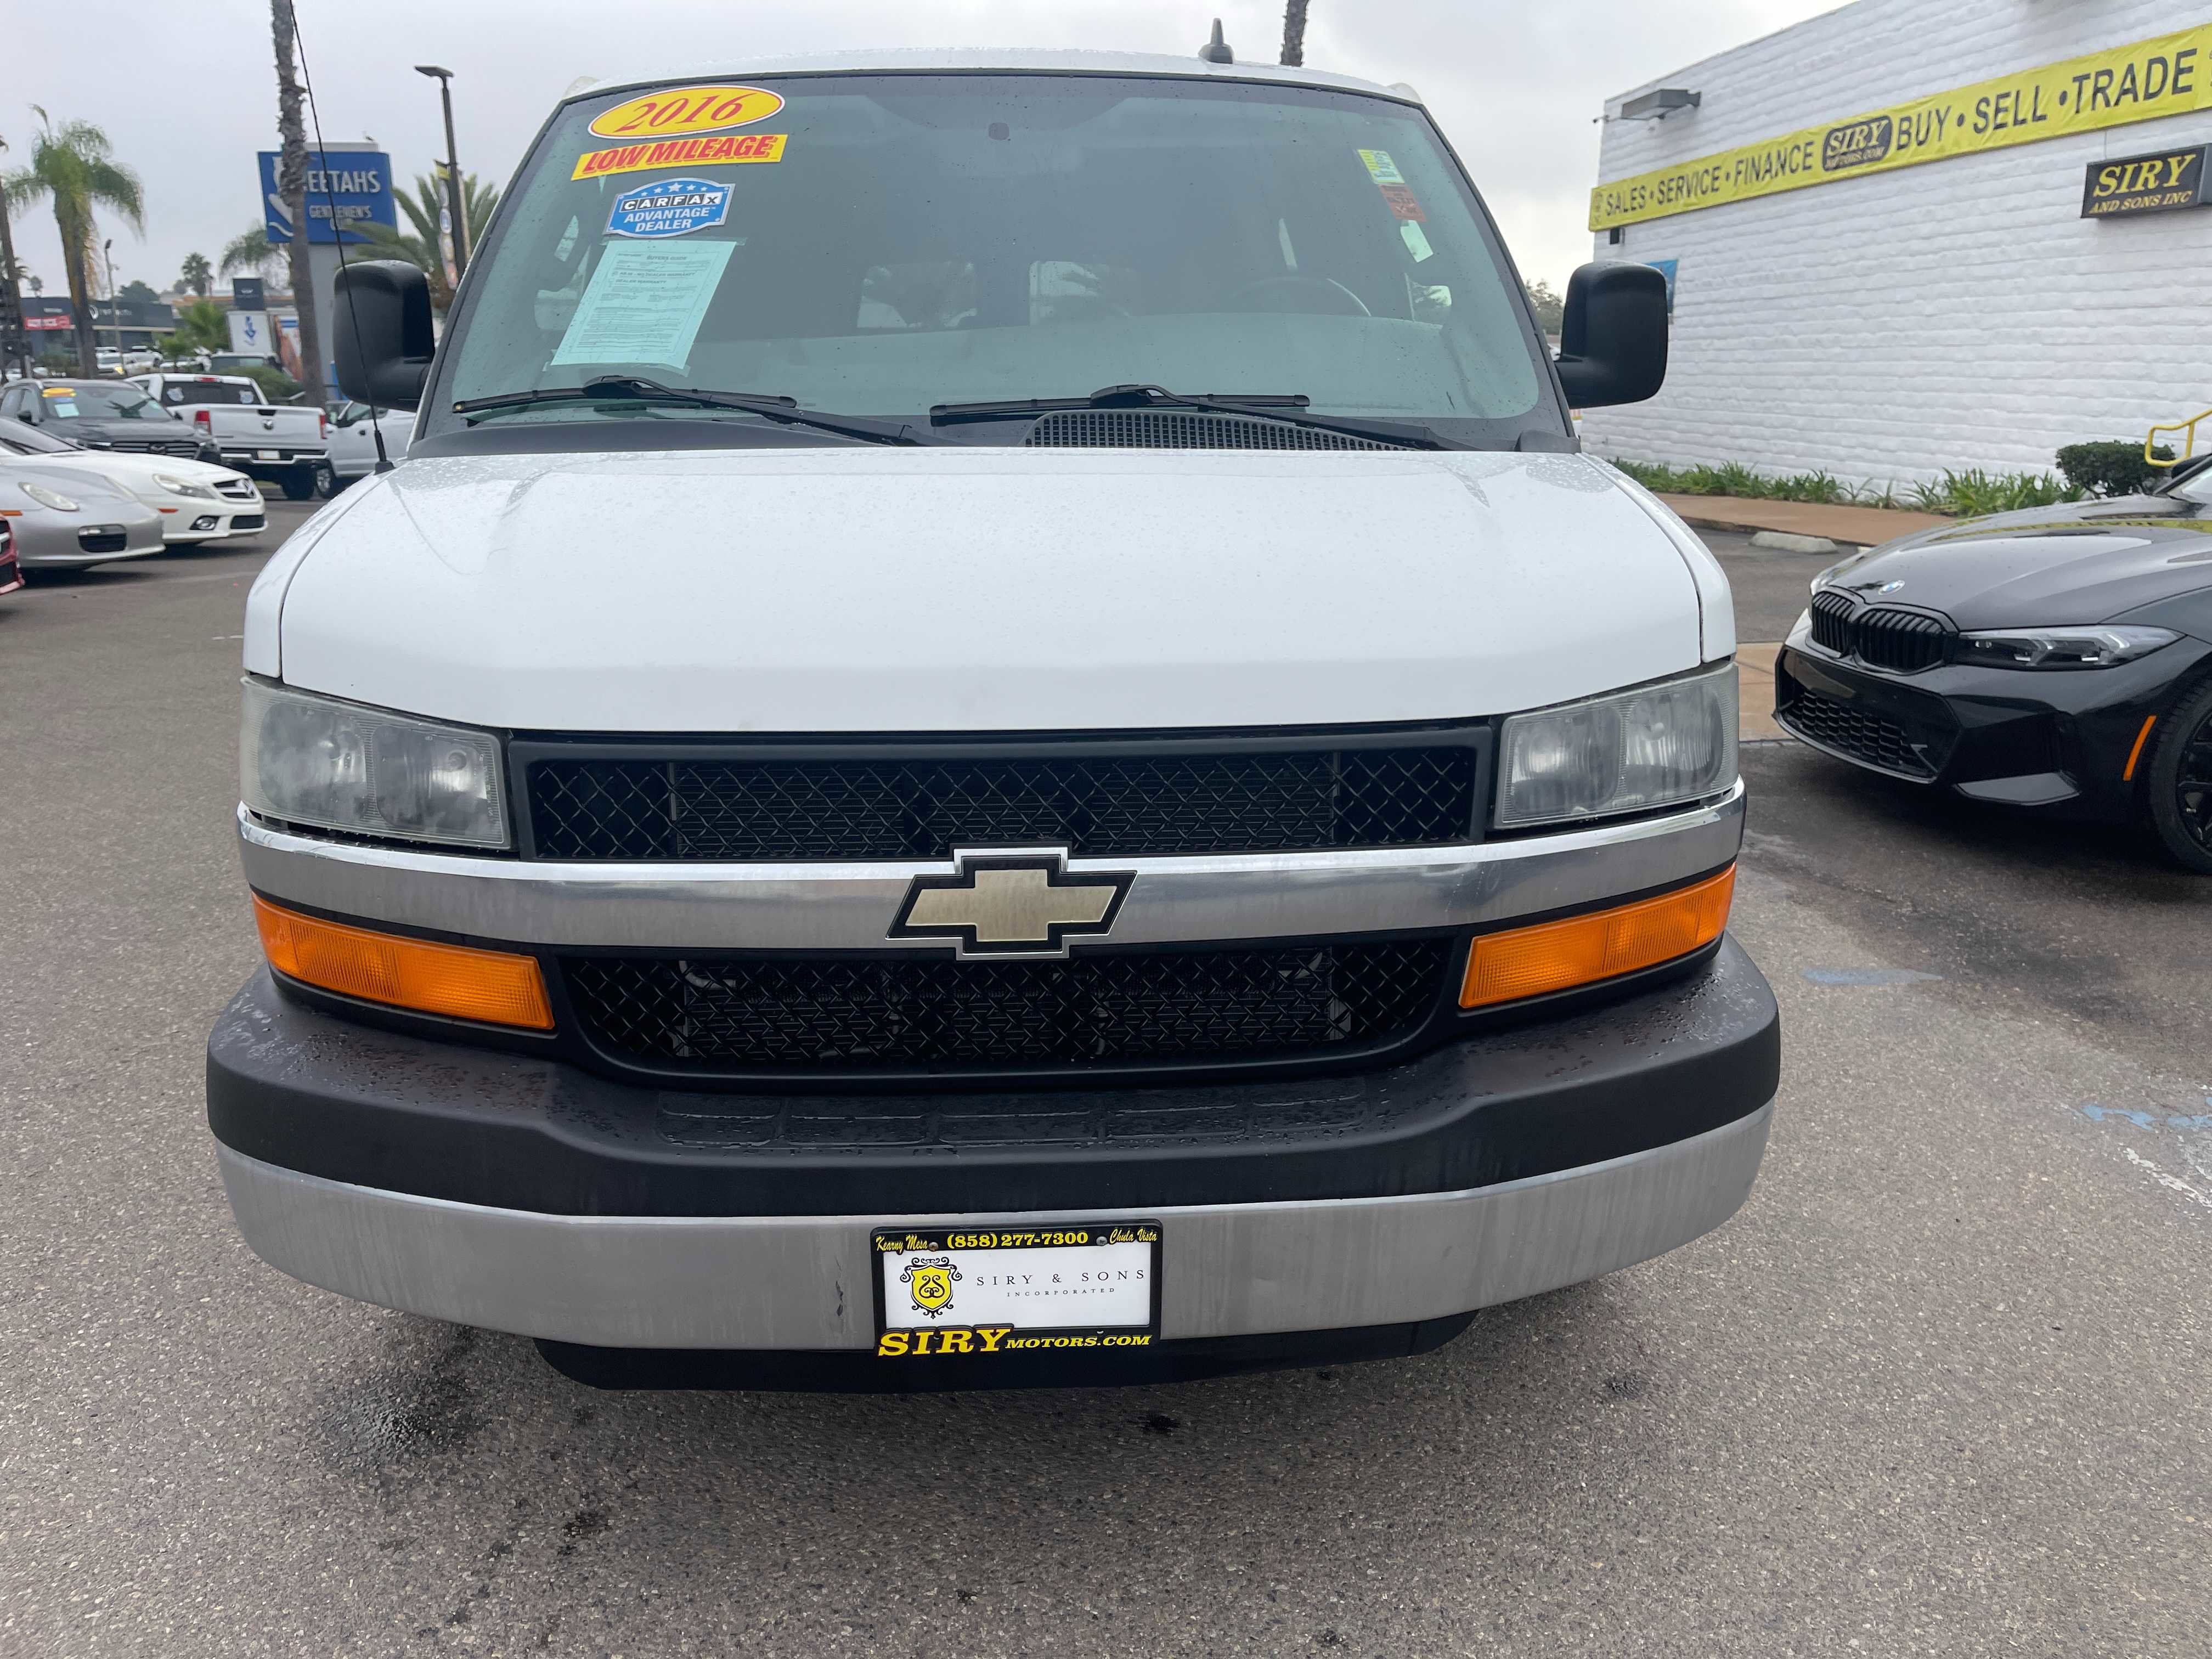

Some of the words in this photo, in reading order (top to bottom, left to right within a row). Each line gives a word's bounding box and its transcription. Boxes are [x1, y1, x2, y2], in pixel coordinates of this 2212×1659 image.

[1896, 105, 1951, 150] BUY
[1973, 85, 2047, 134] SELL
[2072, 48, 2198, 115] TRADE
[613, 93, 758, 132] 2016
[1826, 119, 1889, 157] SIRY
[582, 145, 646, 174] LOW
[646, 136, 777, 164] MILEAGE
[302, 170, 381, 193] EETAHS
[1606, 185, 1646, 216] SALES
[1657, 166, 1721, 205] SERVICE
[1734, 141, 1815, 188] FINANCE
[2093, 154, 2197, 198] SIRY
[622, 194, 721, 211] CARFAX
[2089, 200, 2120, 214] AND
[2121, 195, 2162, 210] SONS
[2163, 190, 2194, 205] INC
[623, 207, 710, 223] ADVANTAGE
[635, 219, 692, 233] DEALER
[876, 1235, 904, 1254] Kearny
[906, 1234, 928, 1251] Mesa
[1109, 1228, 1134, 1244] Chula
[1137, 1228, 1158, 1242] Vista
[977, 1274, 1033, 1286] SIRY
[1052, 1273, 1062, 1283] &
[1081, 1269, 1144, 1282] SONS
[1007, 1288, 1115, 1297] INCORPORATED
